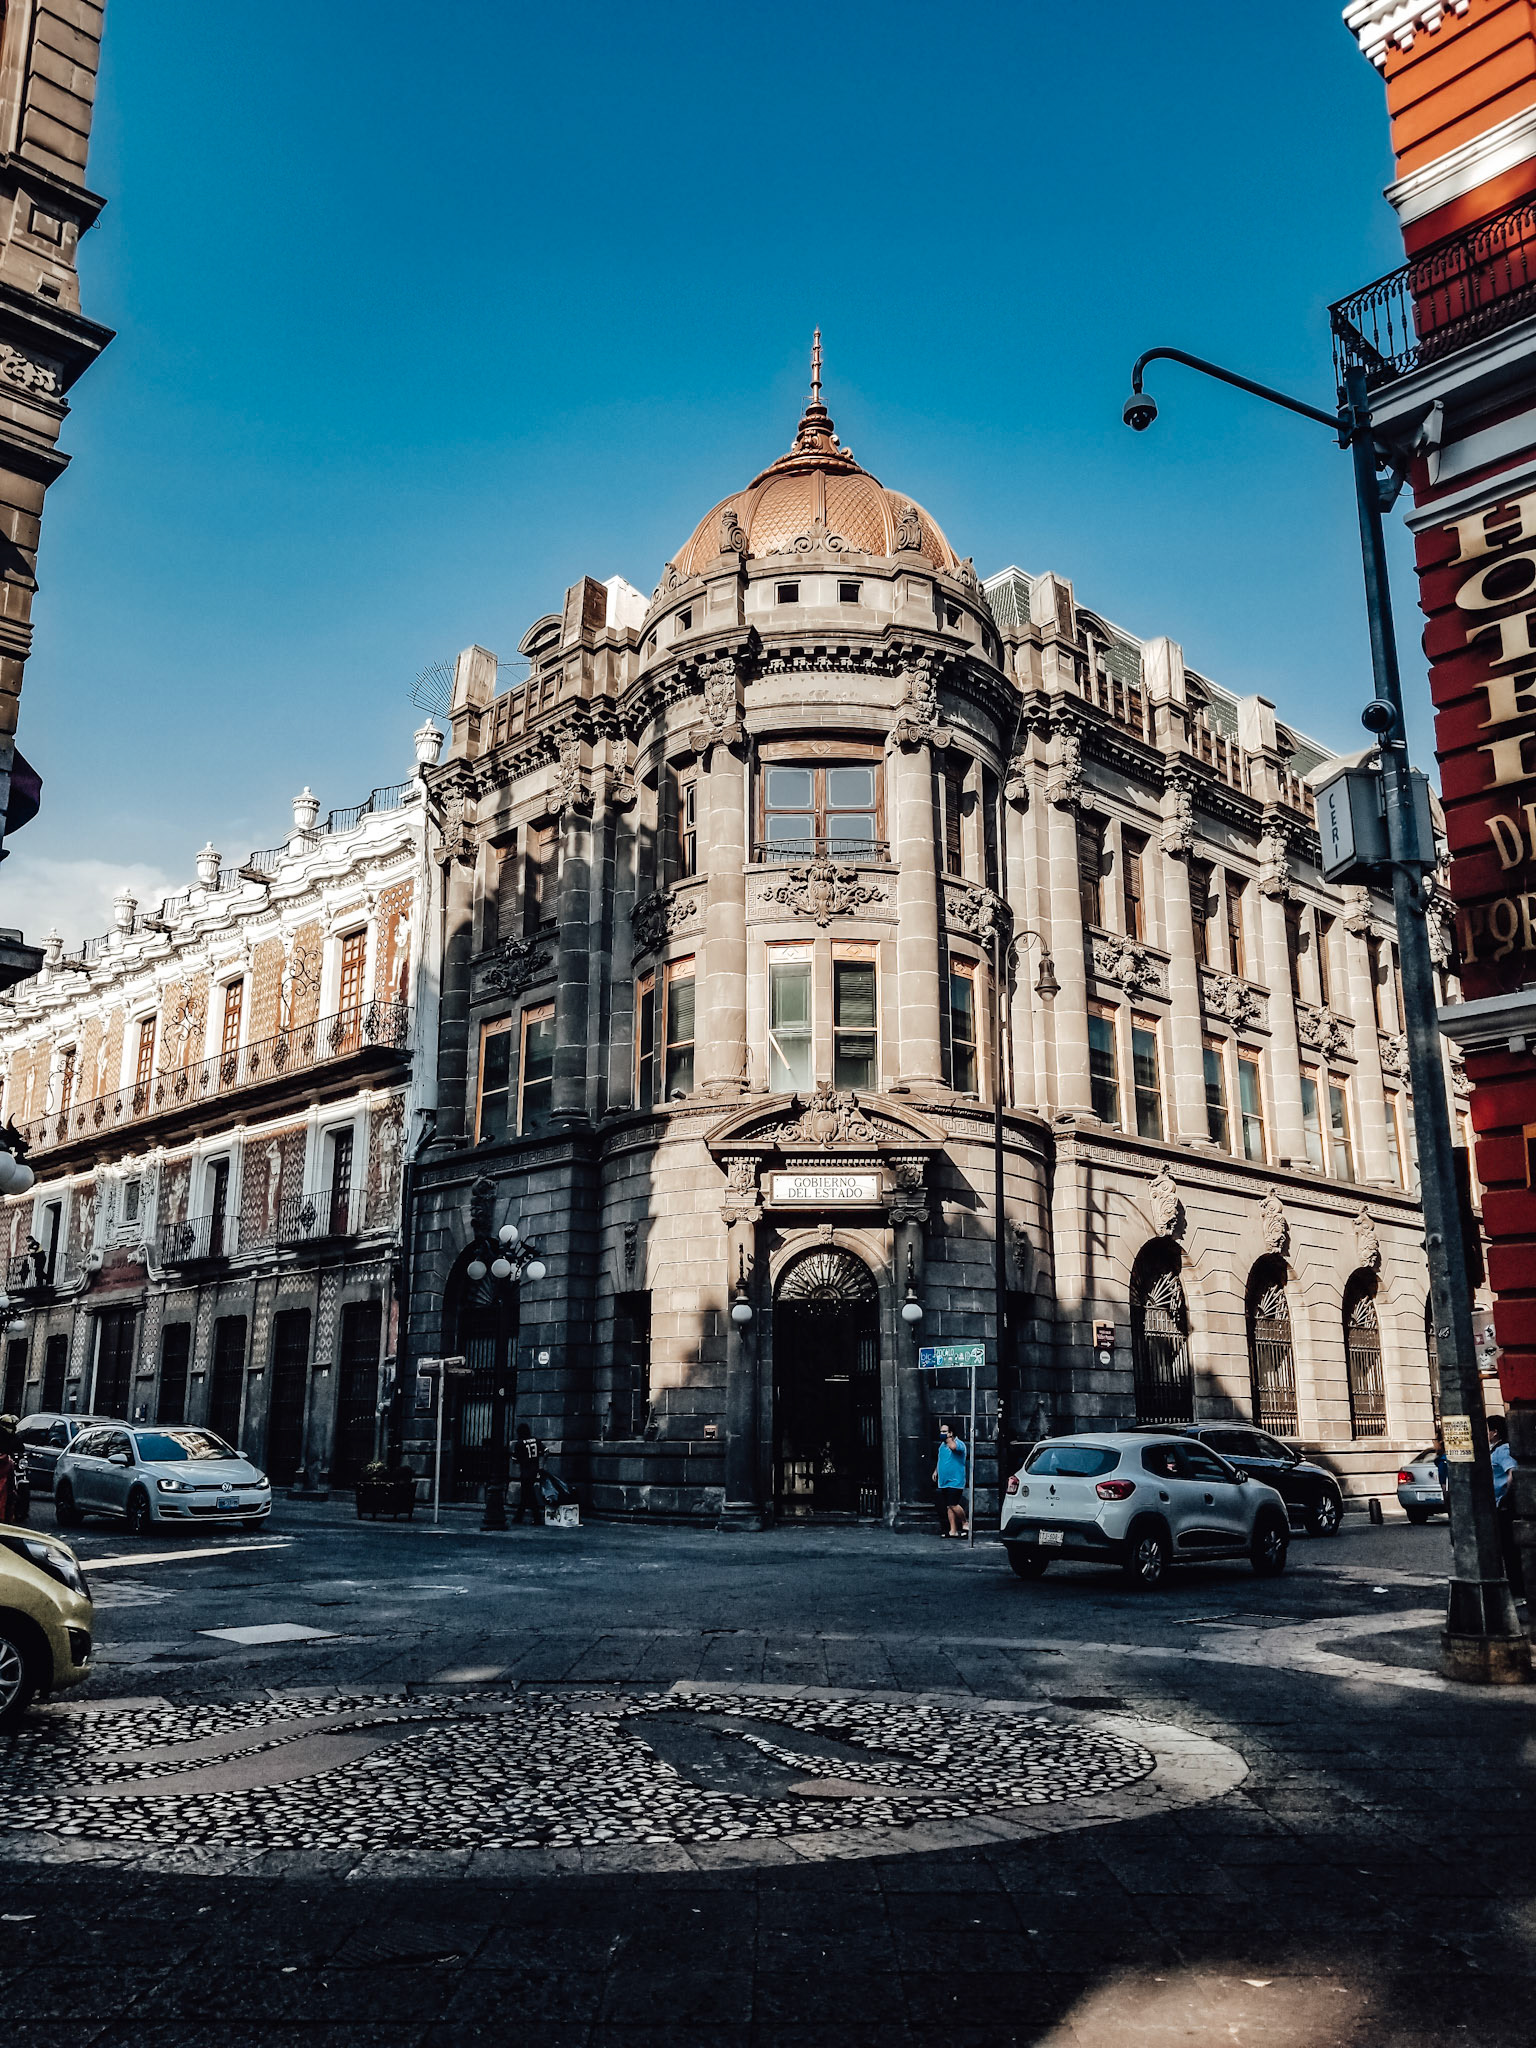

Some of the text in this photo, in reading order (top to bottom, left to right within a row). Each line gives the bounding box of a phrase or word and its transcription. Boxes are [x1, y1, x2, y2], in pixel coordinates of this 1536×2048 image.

[1443, 491, 1536, 793] HOTEL
[1329, 793, 1339, 859] CERI
[794, 1177, 856, 1187] GOBIERNO
[788, 1188, 863, 1198] DEL ESTADO
[525, 1443, 538, 1459] 13
